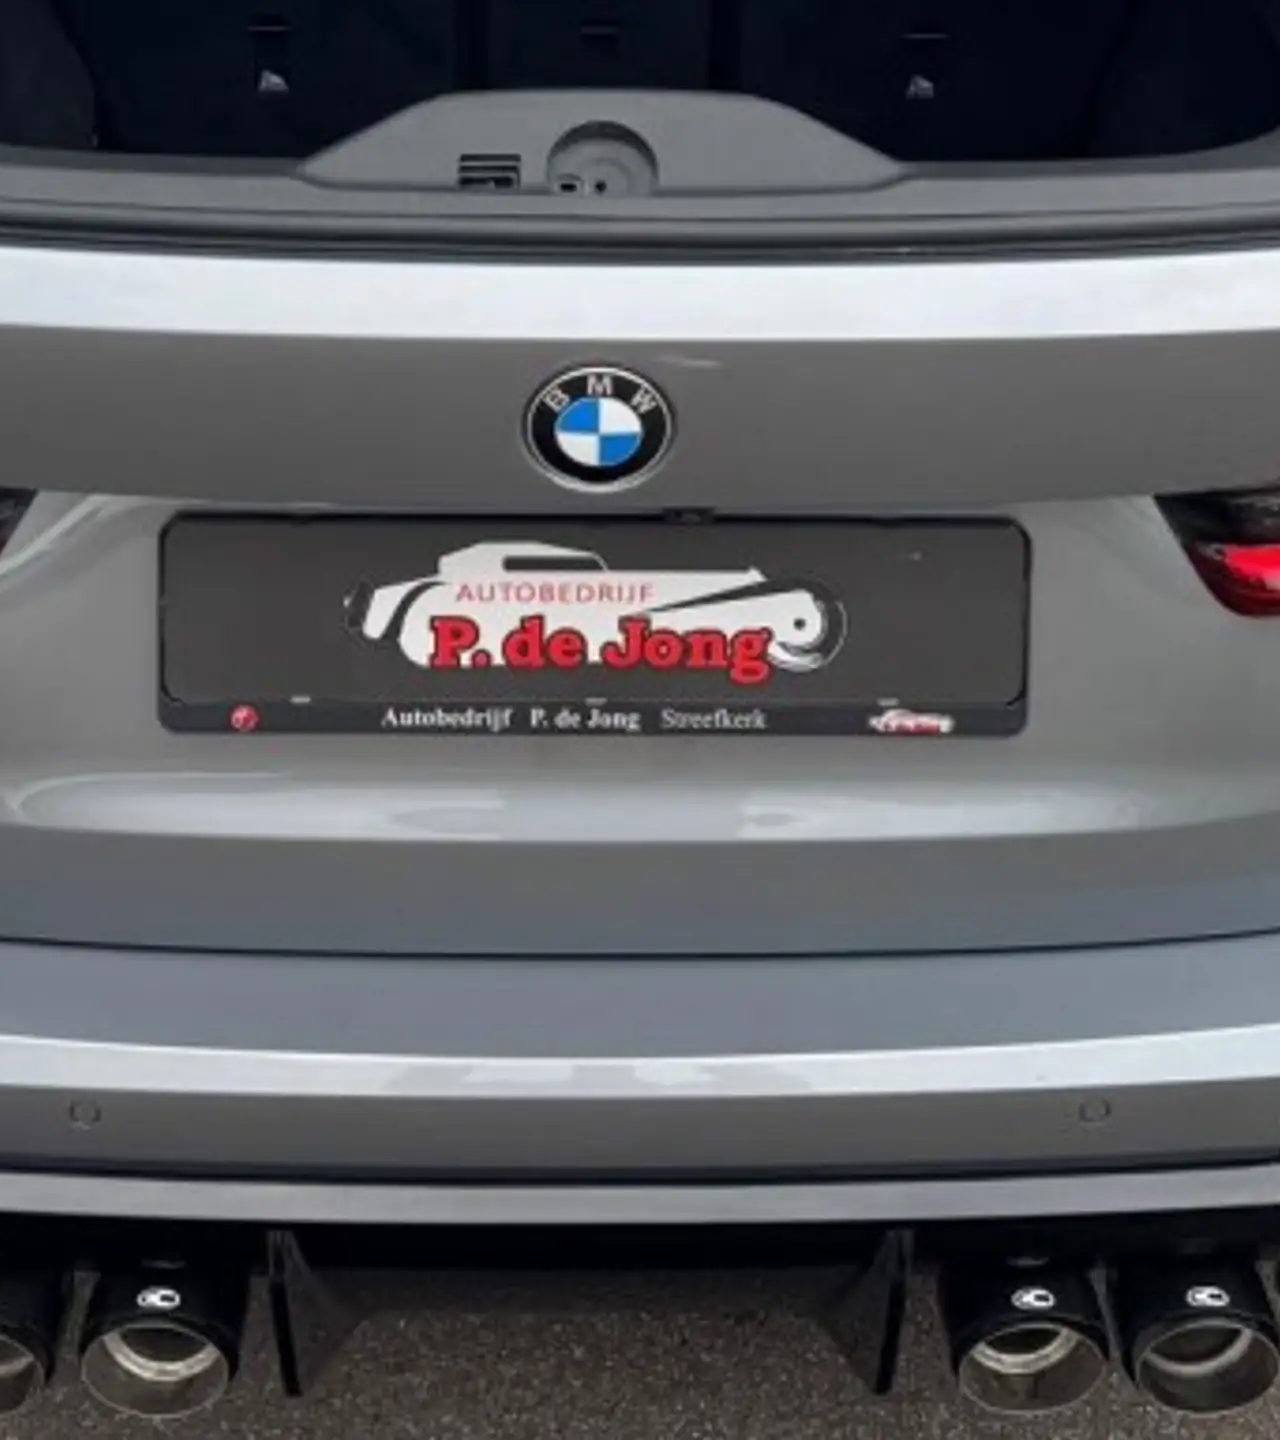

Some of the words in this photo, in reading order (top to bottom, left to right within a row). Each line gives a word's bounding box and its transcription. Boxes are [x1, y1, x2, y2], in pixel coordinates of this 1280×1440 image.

[542, 374, 657, 414] BMW
[456, 581, 656, 604] AUTOBEDRIJF
[428, 614, 493, 671] P.
[502, 613, 588, 671] de
[600, 614, 775, 685] Jong
[381, 707, 514, 732] Autobedrijf
[530, 709, 550, 729] P.
[554, 708, 582, 729] de
[586, 708, 642, 732] Jong
[660, 708, 767, 730] Streefkerk
